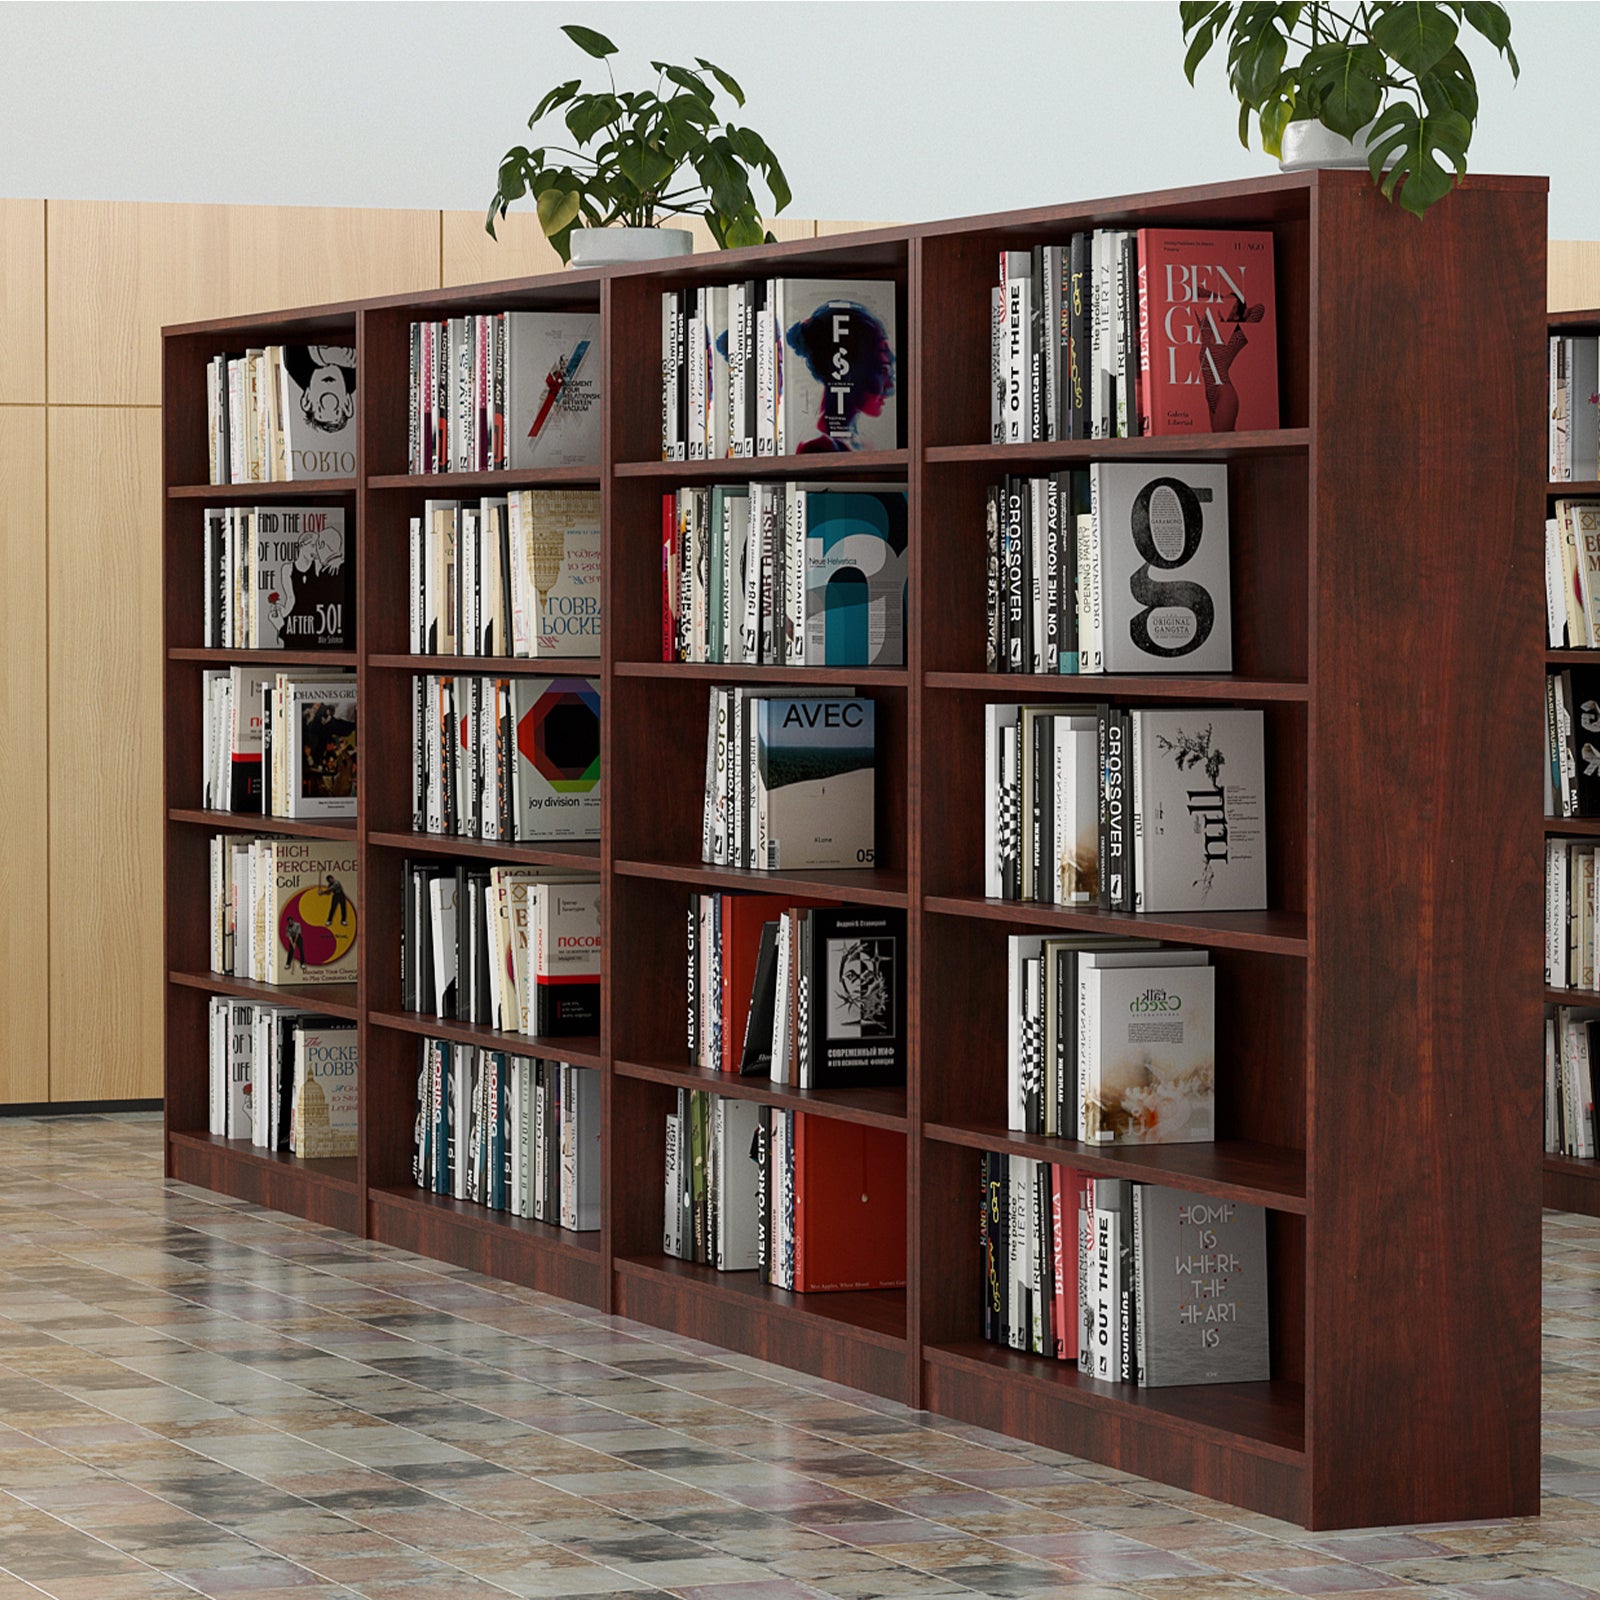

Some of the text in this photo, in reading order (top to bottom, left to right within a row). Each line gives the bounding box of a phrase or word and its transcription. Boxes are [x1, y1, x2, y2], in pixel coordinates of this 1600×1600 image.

[1164, 264, 1246, 303] BEN
[1060, 300, 1068, 346] HANDS
[1093, 284, 1101, 350] the police
[1138, 264, 1149, 372] BENGALA
[1165, 305, 1224, 345] GA
[496, 326, 504, 380] division
[1010, 285, 1020, 412] OUT THERE
[1168, 346, 1224, 385] LA
[1032, 353, 1040, 438] Mountains
[258, 513, 328, 533] FIND THE LOVE
[258, 542, 270, 562] OF
[1010, 495, 1020, 622] CROSSOVER
[1048, 480, 1057, 636] ON THE ROAD AGAIN
[1090, 477, 1100, 630] ORIGINAL GANGSTA
[258, 570, 276, 590] LIFE
[748, 580, 756, 618] 1984
[763, 574, 772, 618] WAR
[286, 604, 342, 634] AFTER 50!
[988, 570, 996, 643] JANE EYRE
[1153, 618, 1190, 626] ORIGINAL
[1154, 626, 1190, 634] GANGSTA
[782, 704, 864, 728] AVEC
[528, 796, 544, 808] joy
[544, 796, 580, 807] division
[1110, 726, 1121, 857] CROSSOVER
[276, 846, 309, 858] HIGH
[814, 836, 832, 844] Alone
[856, 849, 874, 862] 05
[276, 860, 358, 872] PERCENTAGE
[276, 876, 300, 888] Golf
[233, 1006, 252, 1025] FIND
[233, 1035, 244, 1054] OF
[233, 1064, 250, 1082] LIFE
[758, 1122, 766, 1265] NEW YORK CITY
[1052, 1192, 1064, 1296] BENGALA
[1099, 1218, 1108, 1346] OUT THERE
[1121, 1292, 1130, 1380] Mountains
